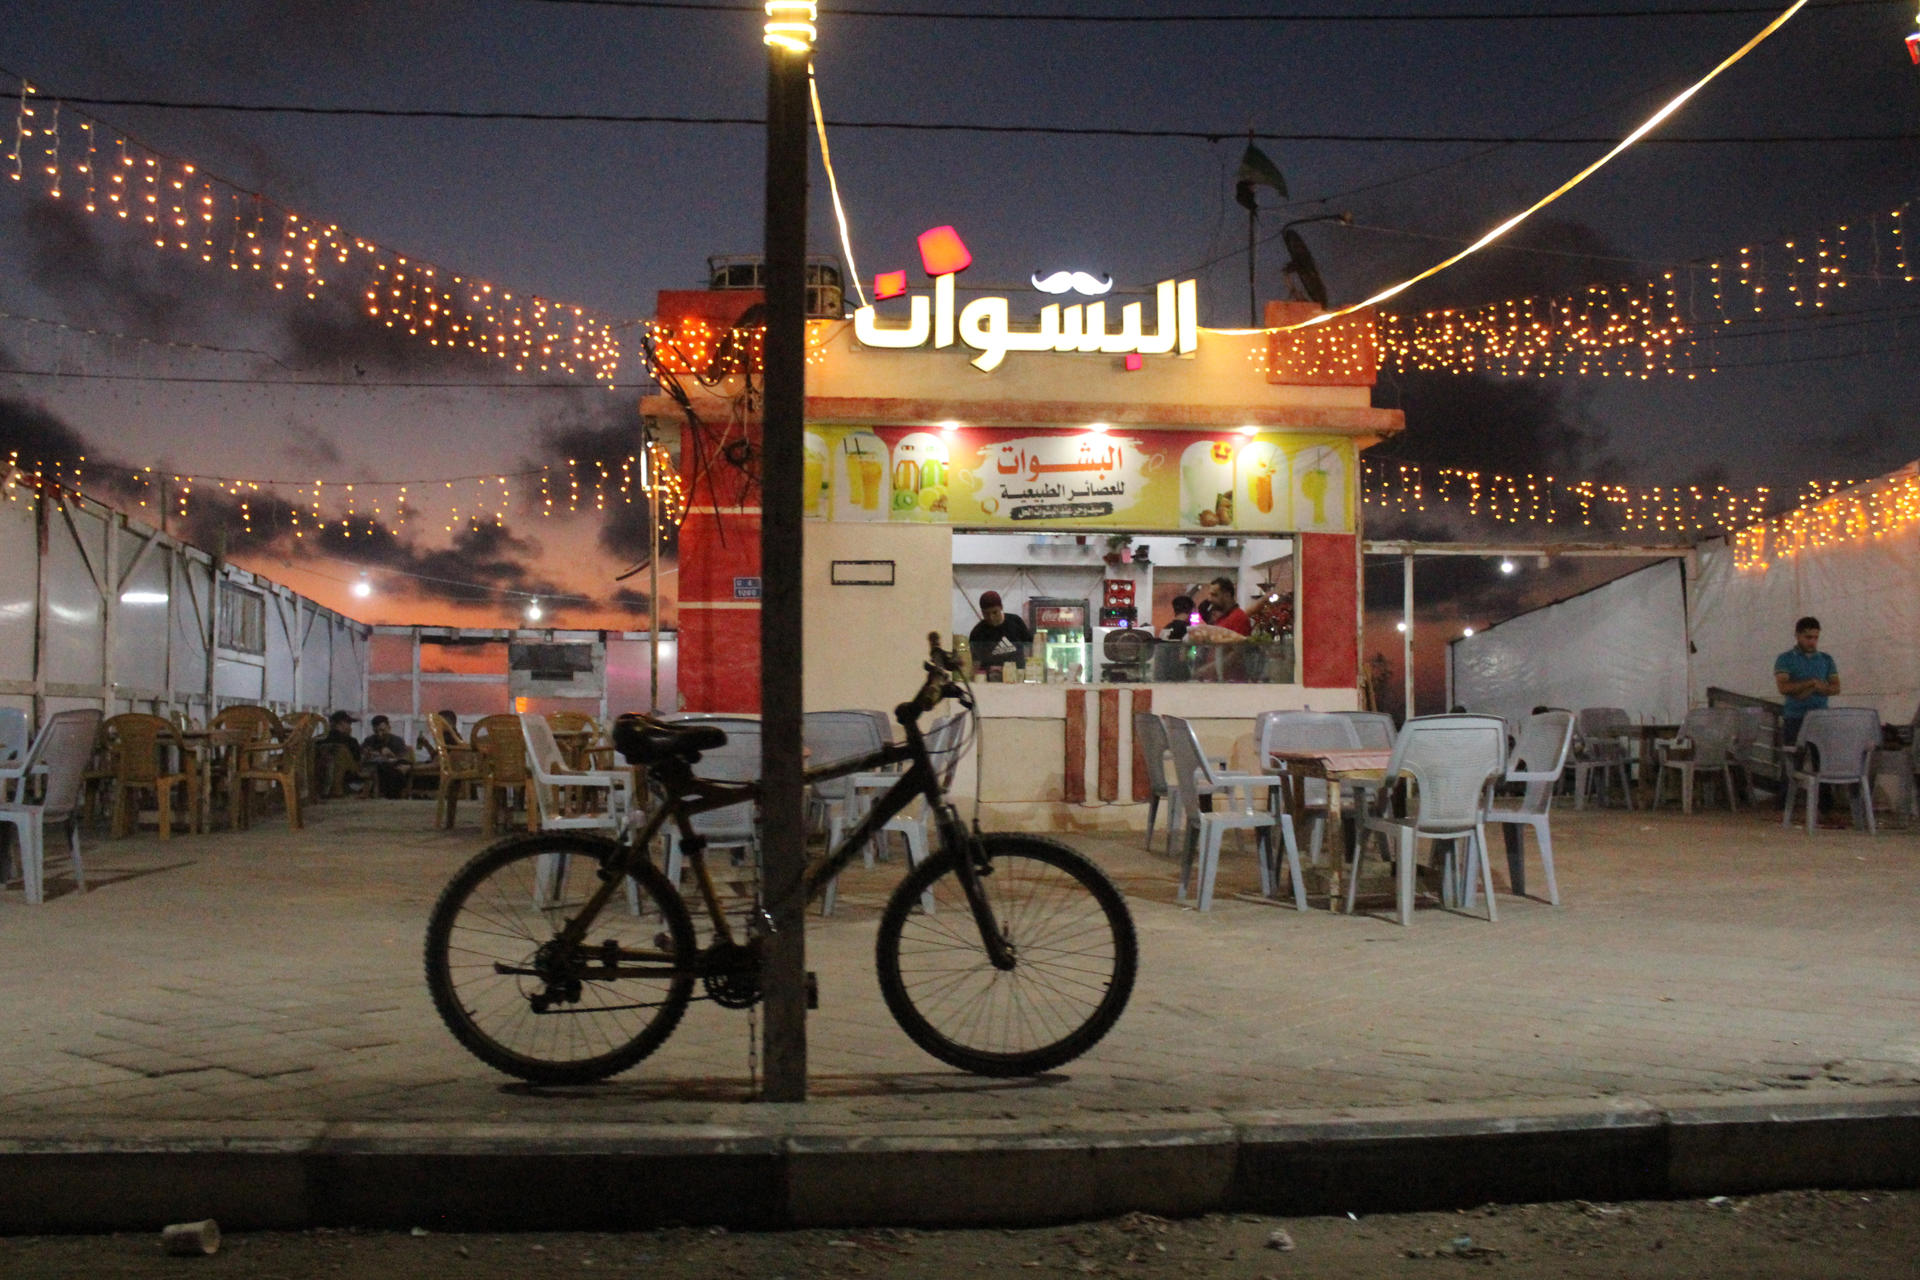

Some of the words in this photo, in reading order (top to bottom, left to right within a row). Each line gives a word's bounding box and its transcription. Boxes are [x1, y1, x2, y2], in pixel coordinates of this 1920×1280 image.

[997, 441, 1124, 482] البشوات
[999, 482, 1066, 504] الطبيعية
[1067, 480, 1126, 502] للعصائر
